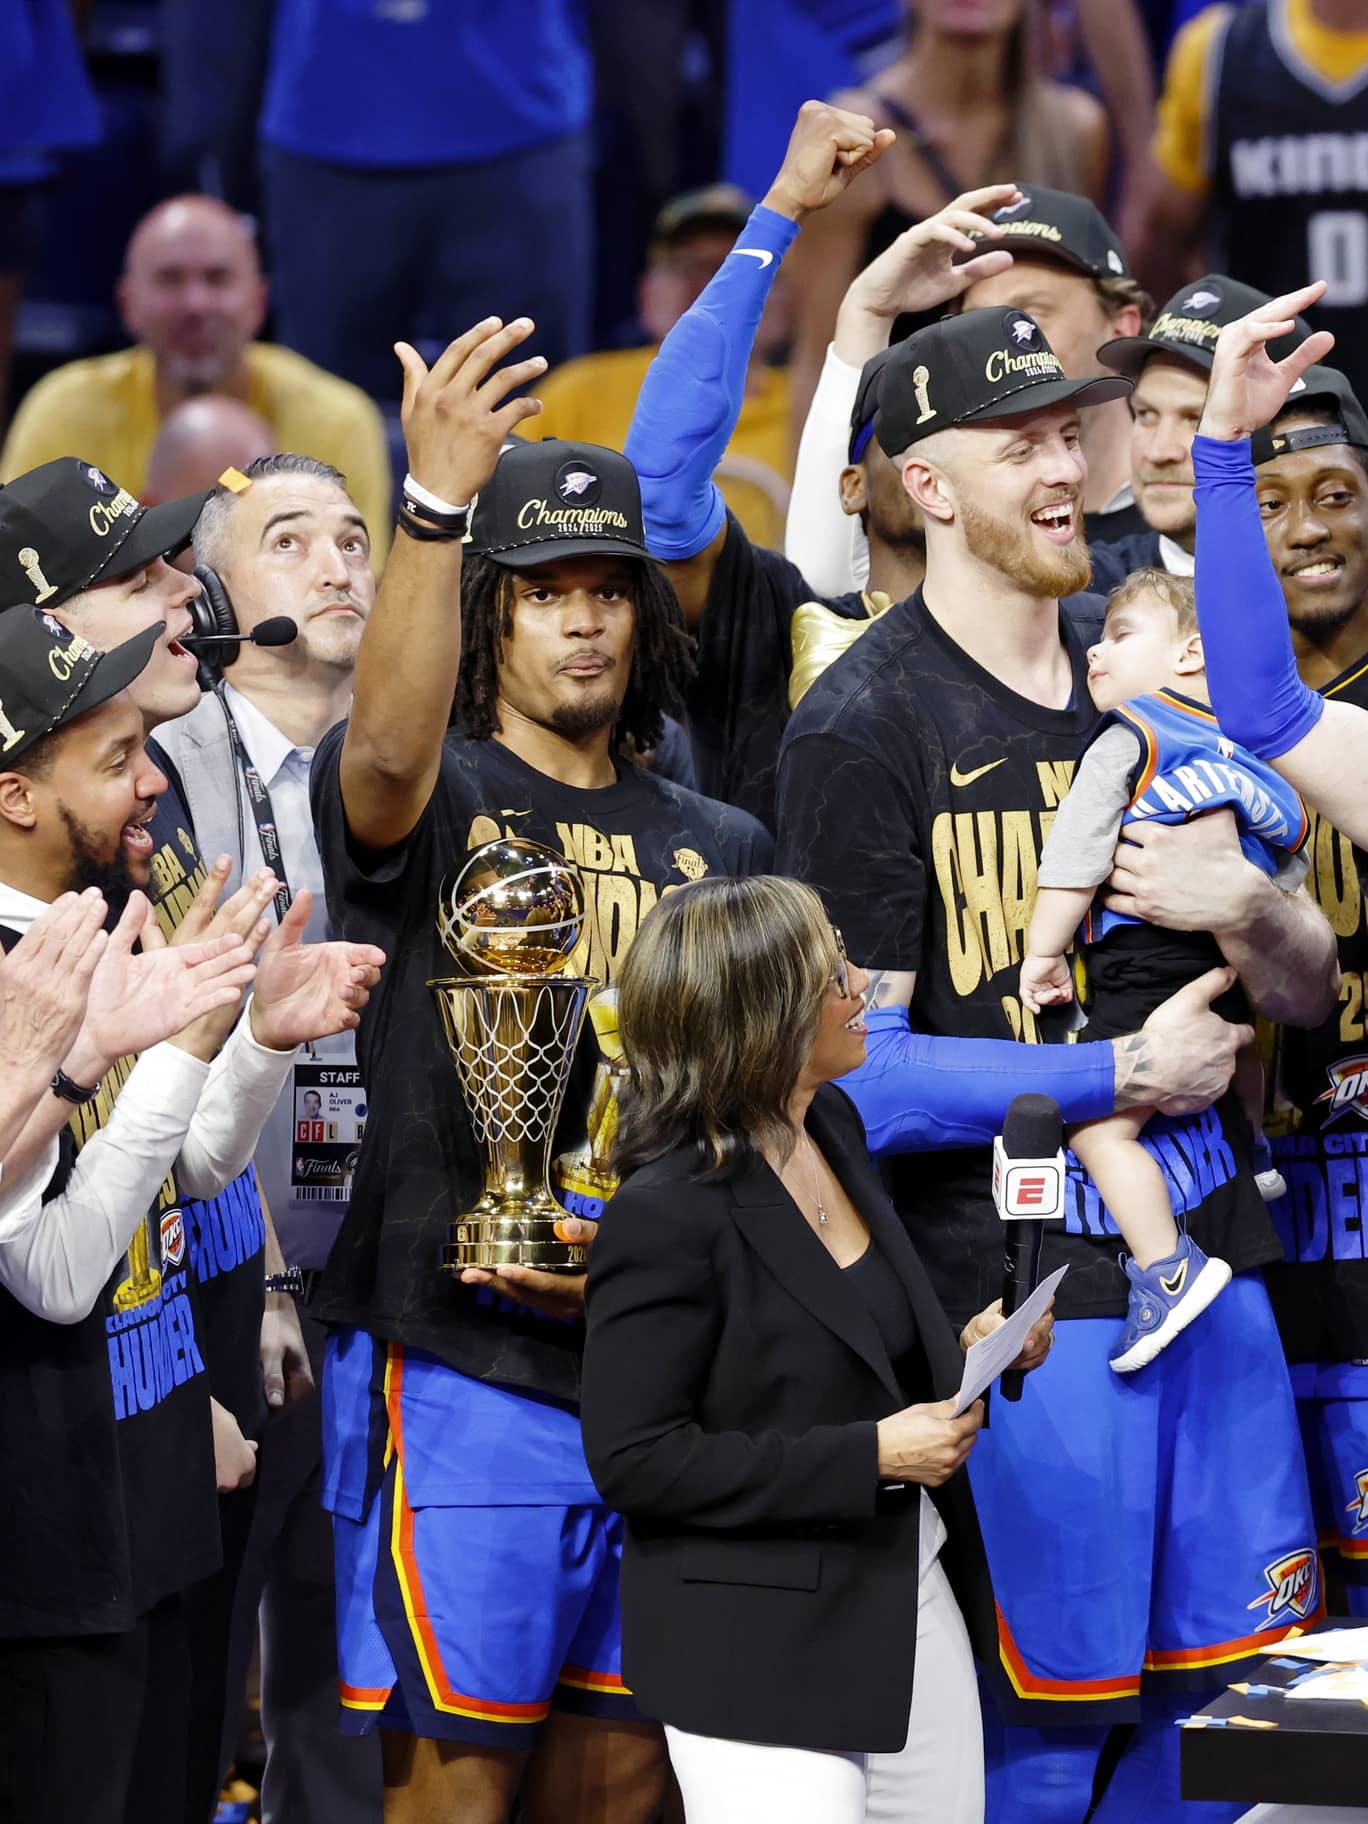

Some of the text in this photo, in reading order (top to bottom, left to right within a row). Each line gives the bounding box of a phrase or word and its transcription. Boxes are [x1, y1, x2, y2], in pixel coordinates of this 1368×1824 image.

[517, 499, 628, 537] Champions
[555, 821, 642, 877] NBA
[320, 1072, 360, 1084] STAFF
[304, 1158, 342, 1178] Finals
[1273, 1561, 1312, 1606] OKC
